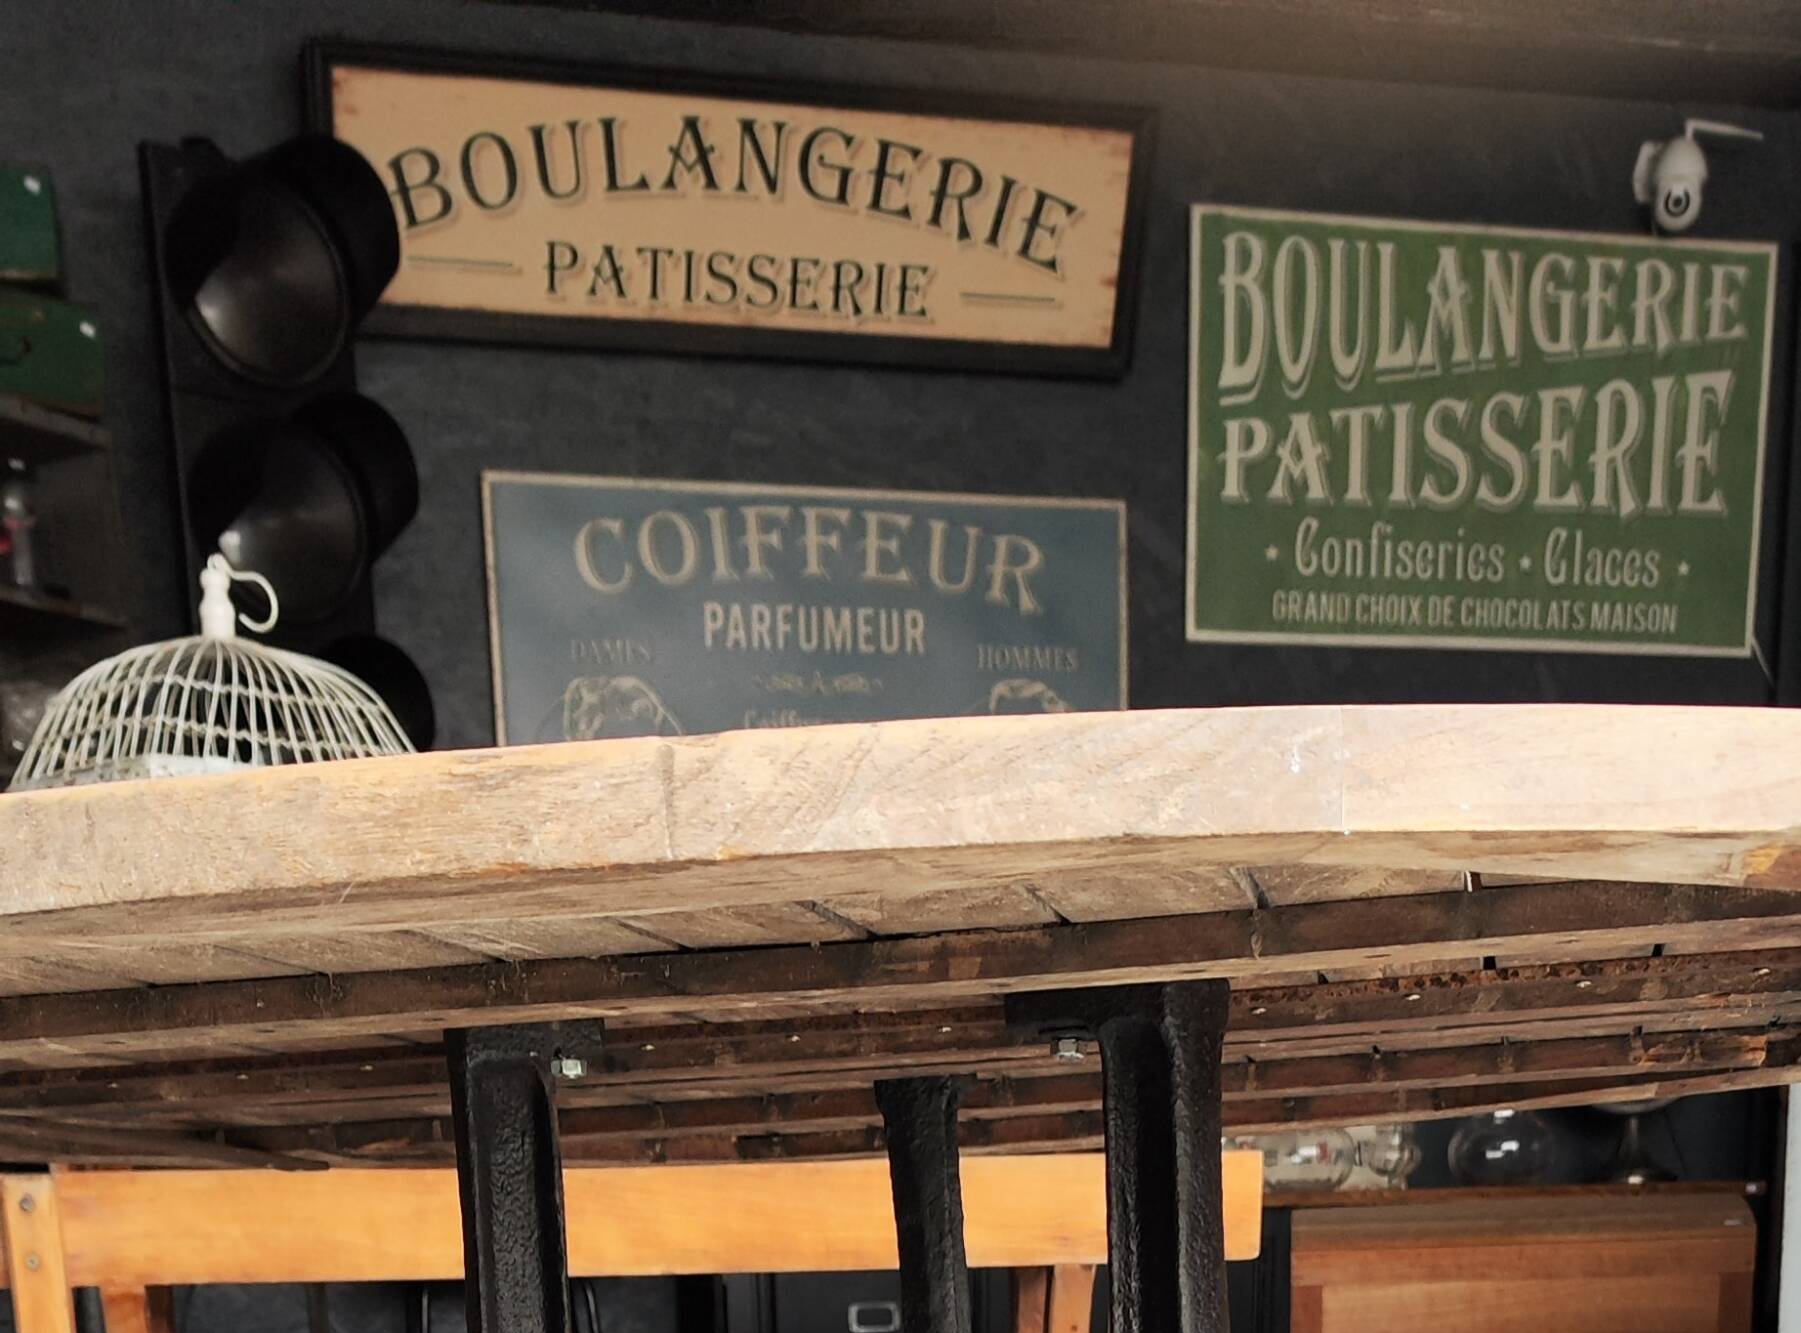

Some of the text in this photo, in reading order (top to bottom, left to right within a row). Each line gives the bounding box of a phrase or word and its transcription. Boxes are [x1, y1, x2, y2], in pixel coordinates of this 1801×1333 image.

[388, 115, 1081, 276] BOULANGERIE
[544, 241, 932, 320] PATISSERIE
[1218, 231, 1750, 402] BOULANGERIE
[1218, 370, 1733, 518] PATISSERIE
[573, 504, 1045, 615] COIFFEUR
[1294, 516, 1661, 587] Confiseries Glaces
[703, 600, 926, 656] PARFUMEUR
[1271, 588, 1679, 634] GRAND CHOIX DE CHOCOLATS MAISON
